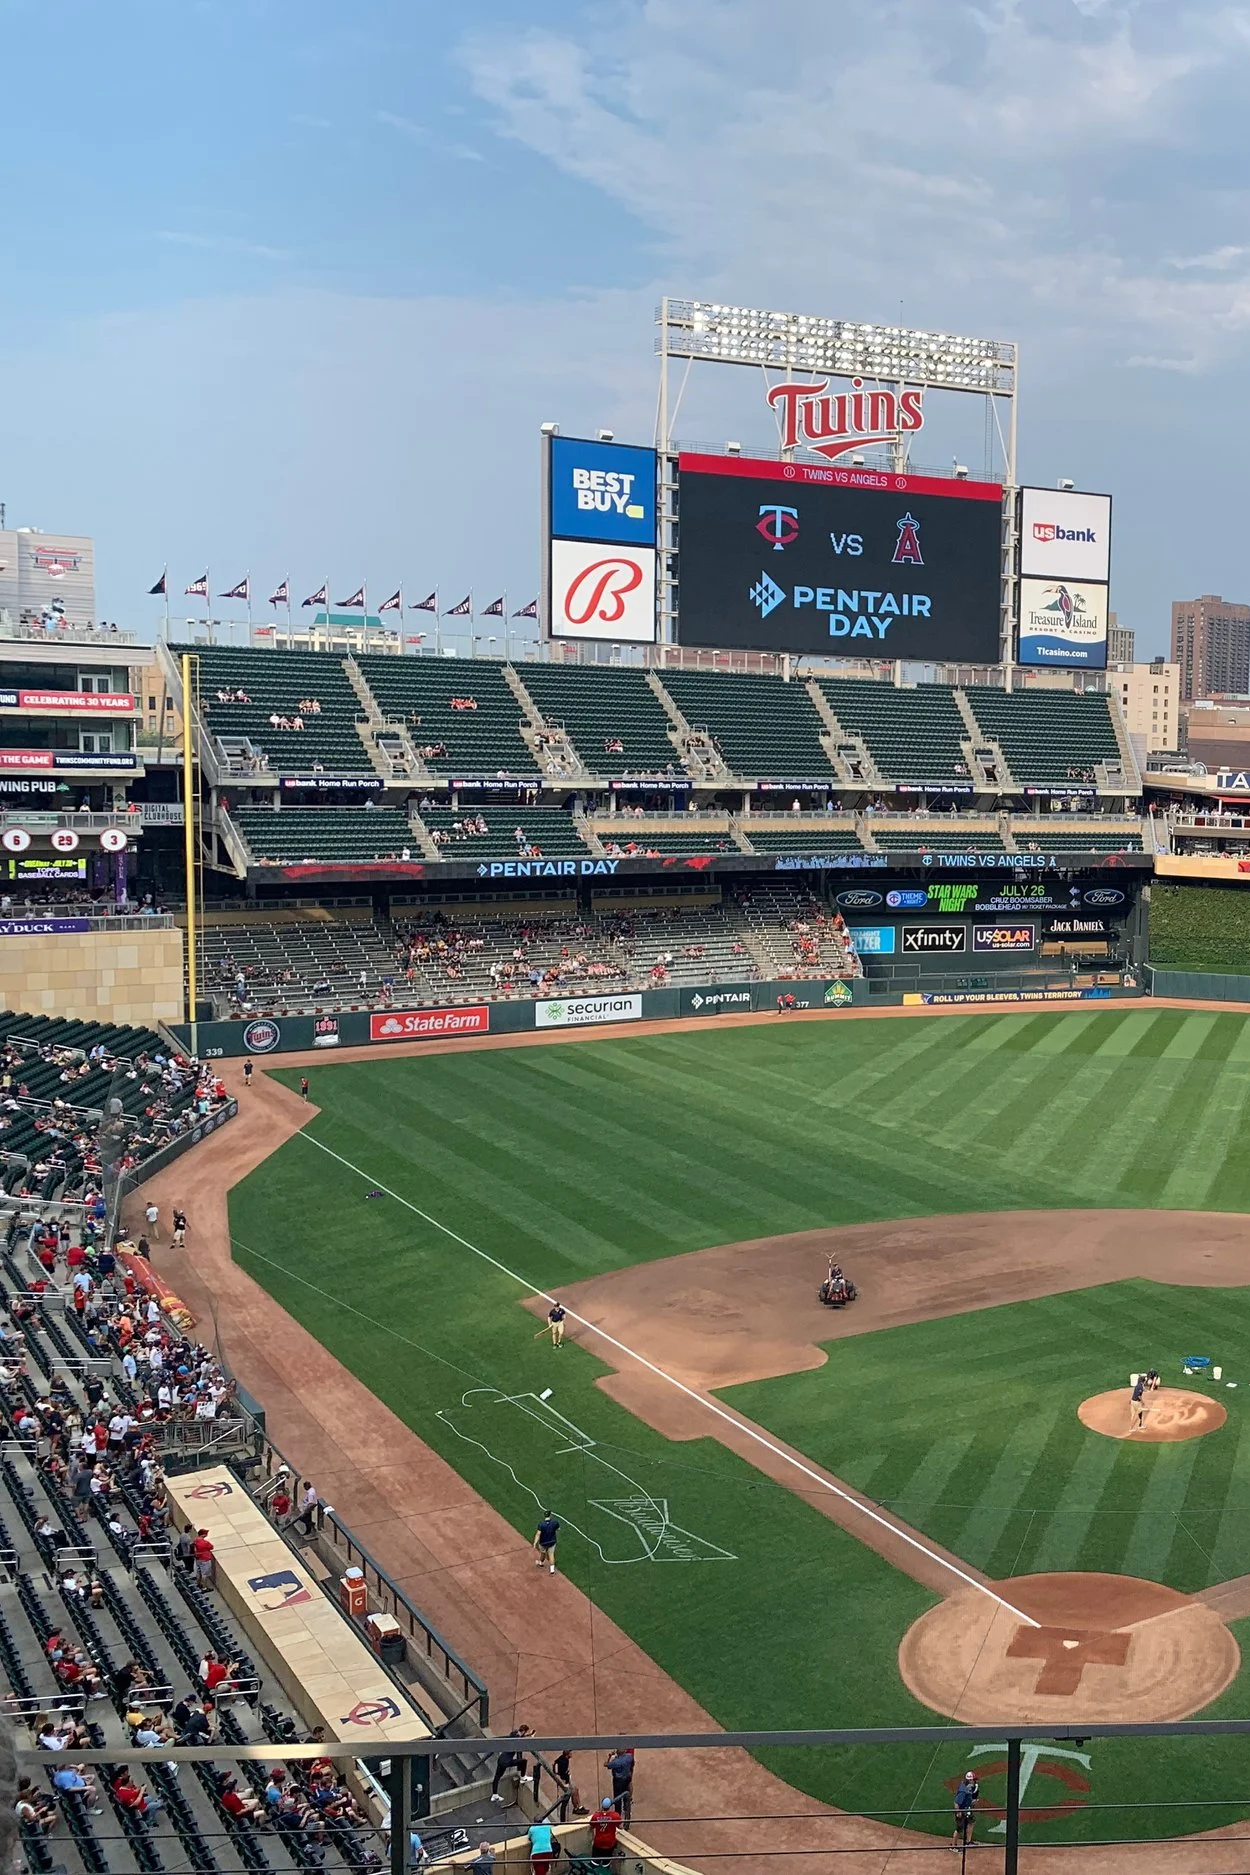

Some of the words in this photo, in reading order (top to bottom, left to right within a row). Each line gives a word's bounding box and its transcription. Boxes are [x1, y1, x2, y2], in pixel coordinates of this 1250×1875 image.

[766, 377, 925, 451] Twins
[573, 468, 635, 494] BEST
[802, 468, 833, 482] TWINS
[834, 471, 848, 483] VS
[849, 473, 888, 487] ANGELS
[577, 490, 630, 513] BUY
[830, 532, 864, 556] VS
[564, 558, 643, 625] B
[793, 586, 932, 617] PENTAIR
[829, 613, 893, 639] DAY
[1028, 611, 1064, 627] Treasure
[1072, 614, 1098, 629] Island
[0, 694, 17, 704] UND
[23, 696, 87, 706] CELEBRATING
[86, 697, 98, 706] 30
[99, 697, 130, 707] YEARS
[2, 755, 20, 763] THE
[22, 755, 50, 764] GAME
[31, 782, 56, 792] PUB
[318, 780, 340, 788] Home
[144, 804, 169, 812] DIGITAL
[144, 812, 182, 820] CLUBHOUSE
[13, 836, 20, 846] 6
[58, 836, 72, 846] 29
[110, 836, 118, 845] 3
[937, 856, 976, 867] TWINS
[978, 856, 996, 867] VS
[998, 856, 1045, 867] ANGELS
[491, 860, 576, 877] PENTAIR
[581, 859, 620, 875] DAY
[928, 885, 952, 898] STAR
[951, 885, 979, 898] WARS
[1000, 885, 1028, 896] JULY
[1030, 886, 1045, 896] 26
[844, 892, 874, 905] Ford
[1091, 891, 1117, 903] Ford
[938, 899, 966, 912] NIGHT
[14, 924, 54, 932] DUCK
[1050, 920, 1072, 932] JACK
[1073, 920, 1105, 932] DANIEL'S
[905, 928, 964, 950] xfinity
[706, 993, 750, 1005] PENTAIR
[934, 994, 950, 1002] ROLL
[952, 994, 962, 1002] UP
[964, 994, 984, 1002] YOUR
[986, 992, 1018, 1002] SLEEVES,
[1020, 992, 1042, 1000] TWINS
[1044, 990, 1082, 1000] TERRITORY
[567, 1000, 632, 1016] securian
[567, 1014, 607, 1022] FINANCIAL
[316, 1020, 338, 1032] 1991
[248, 1030, 276, 1043] Twins
[206, 1048, 223, 1056] 339
[599, 1822, 608, 1832] 7
